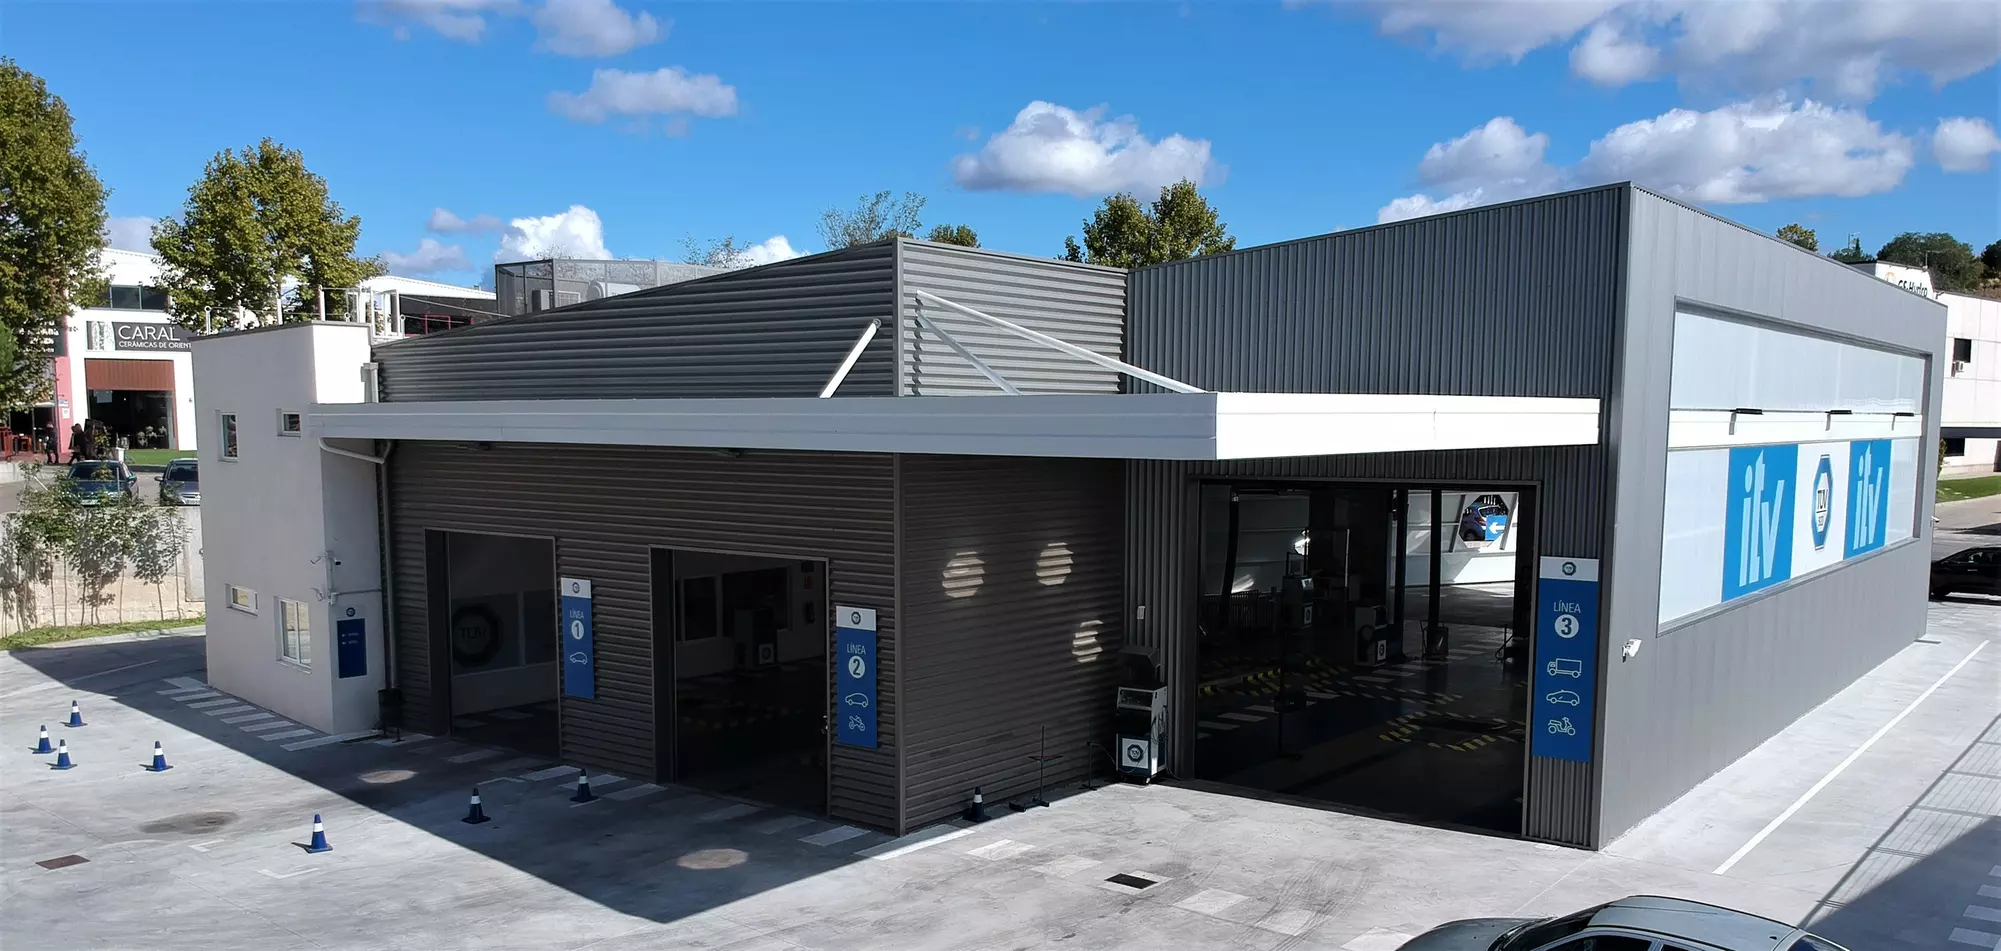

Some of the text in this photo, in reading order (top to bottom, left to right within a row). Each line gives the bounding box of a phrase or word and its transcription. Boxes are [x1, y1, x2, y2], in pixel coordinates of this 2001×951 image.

[118, 325, 180, 341] CARAL
[119, 340, 157, 349] CERÁMICAS
[158, 341, 167, 349] DE
[1853, 443, 1883, 550] itv
[1739, 450, 1785, 587] itv
[1553, 600, 1582, 613] LÍNEA
[1560, 617, 1573, 636] 3
[846, 642, 866, 656] LÍNEA
[852, 658, 861, 676] 2
